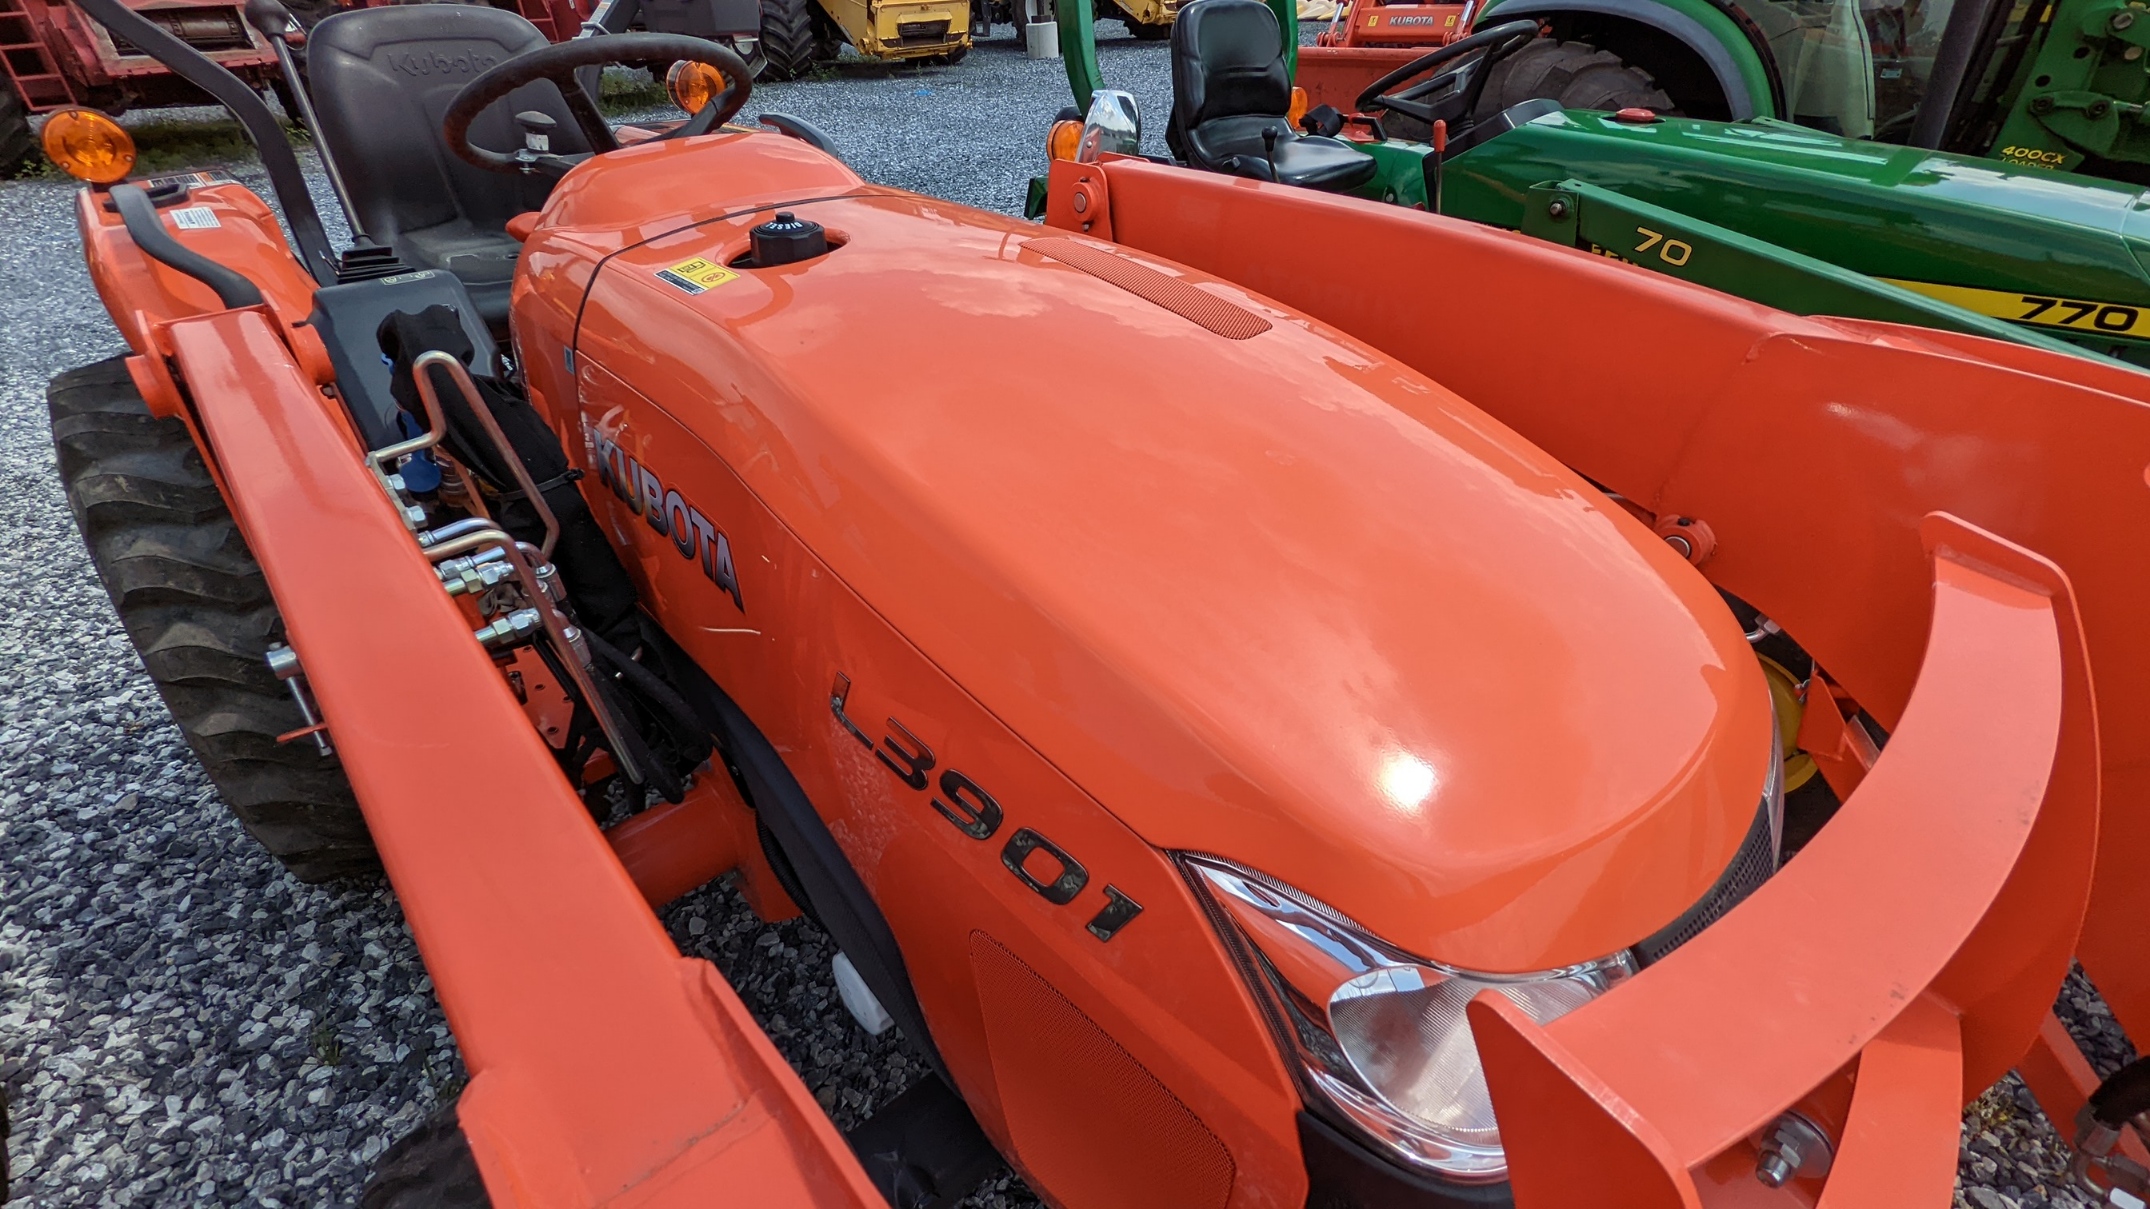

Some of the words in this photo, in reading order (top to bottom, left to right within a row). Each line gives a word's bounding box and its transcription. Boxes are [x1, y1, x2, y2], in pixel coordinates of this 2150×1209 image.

[1389, 16, 1434, 26] KUBOTA
[2001, 145, 2068, 165] 400CX
[1634, 226, 1693, 267] 70
[2018, 295, 2139, 332] 770
[593, 427, 746, 615] KUBOTA
[830, 671, 1144, 943] L3901
